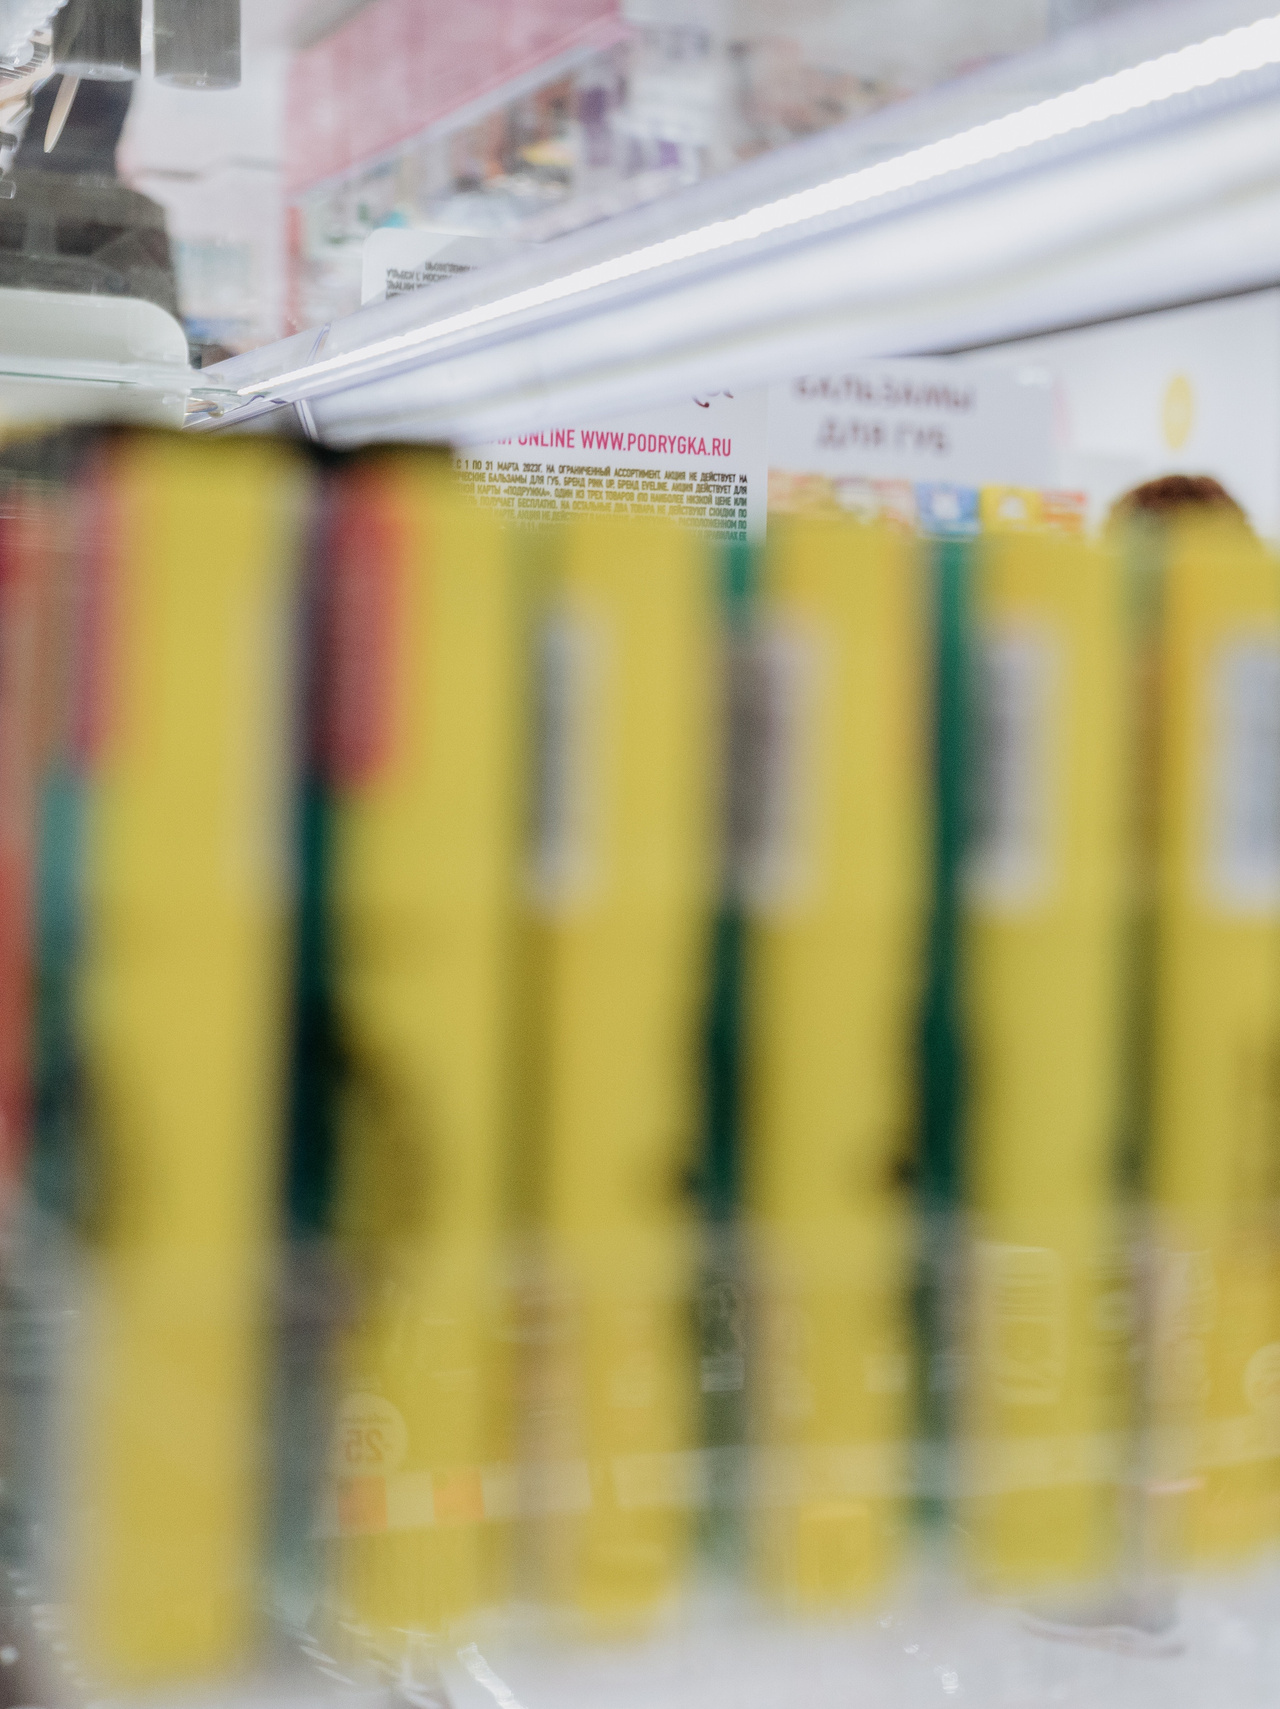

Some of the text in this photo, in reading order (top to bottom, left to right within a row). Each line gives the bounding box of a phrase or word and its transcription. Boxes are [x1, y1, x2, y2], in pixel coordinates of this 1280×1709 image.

[518, 428, 731, 456] ONLINE WWW.PODRYGKA.RU
[817, 416, 949, 456] ДЛЯ ГУБ
[465, 460, 469, 470] 1
[472, 460, 482, 470] ПО
[485, 461, 493, 471] 31
[497, 462, 519, 472] МАРТА
[546, 464, 555, 474] НА
[558, 464, 611, 478] ОГРАНИЧЕННЫЙ
[664, 470, 686, 482] АКЦИЯ
[689, 471, 698, 481] НЕ
[700, 471, 736, 483] ДЕЙСТВУЕТ
[739, 473, 748, 484] НА
[488, 473, 527, 483] БАЛЬЗАМЫ
[529, 475, 544, 485] ДЛЯ
[564, 477, 585, 488] БРЕНД
[617, 480, 640, 491] БРЕНД
[671, 482, 693, 493] АКЦИЯ
[695, 482, 732, 495] ДЕЙСТВУЕТ
[733, 485, 747, 496] ДЛЯ
[686, 494, 713, 506] НИЗКОЙ
[715, 496, 732, 508] ЦЕНЕ
[734, 497, 747, 507] ИЛИ
[708, 507, 735, 519] СКИДКИ
[738, 508, 747, 519] ПО
[738, 519, 747, 529] ПО
